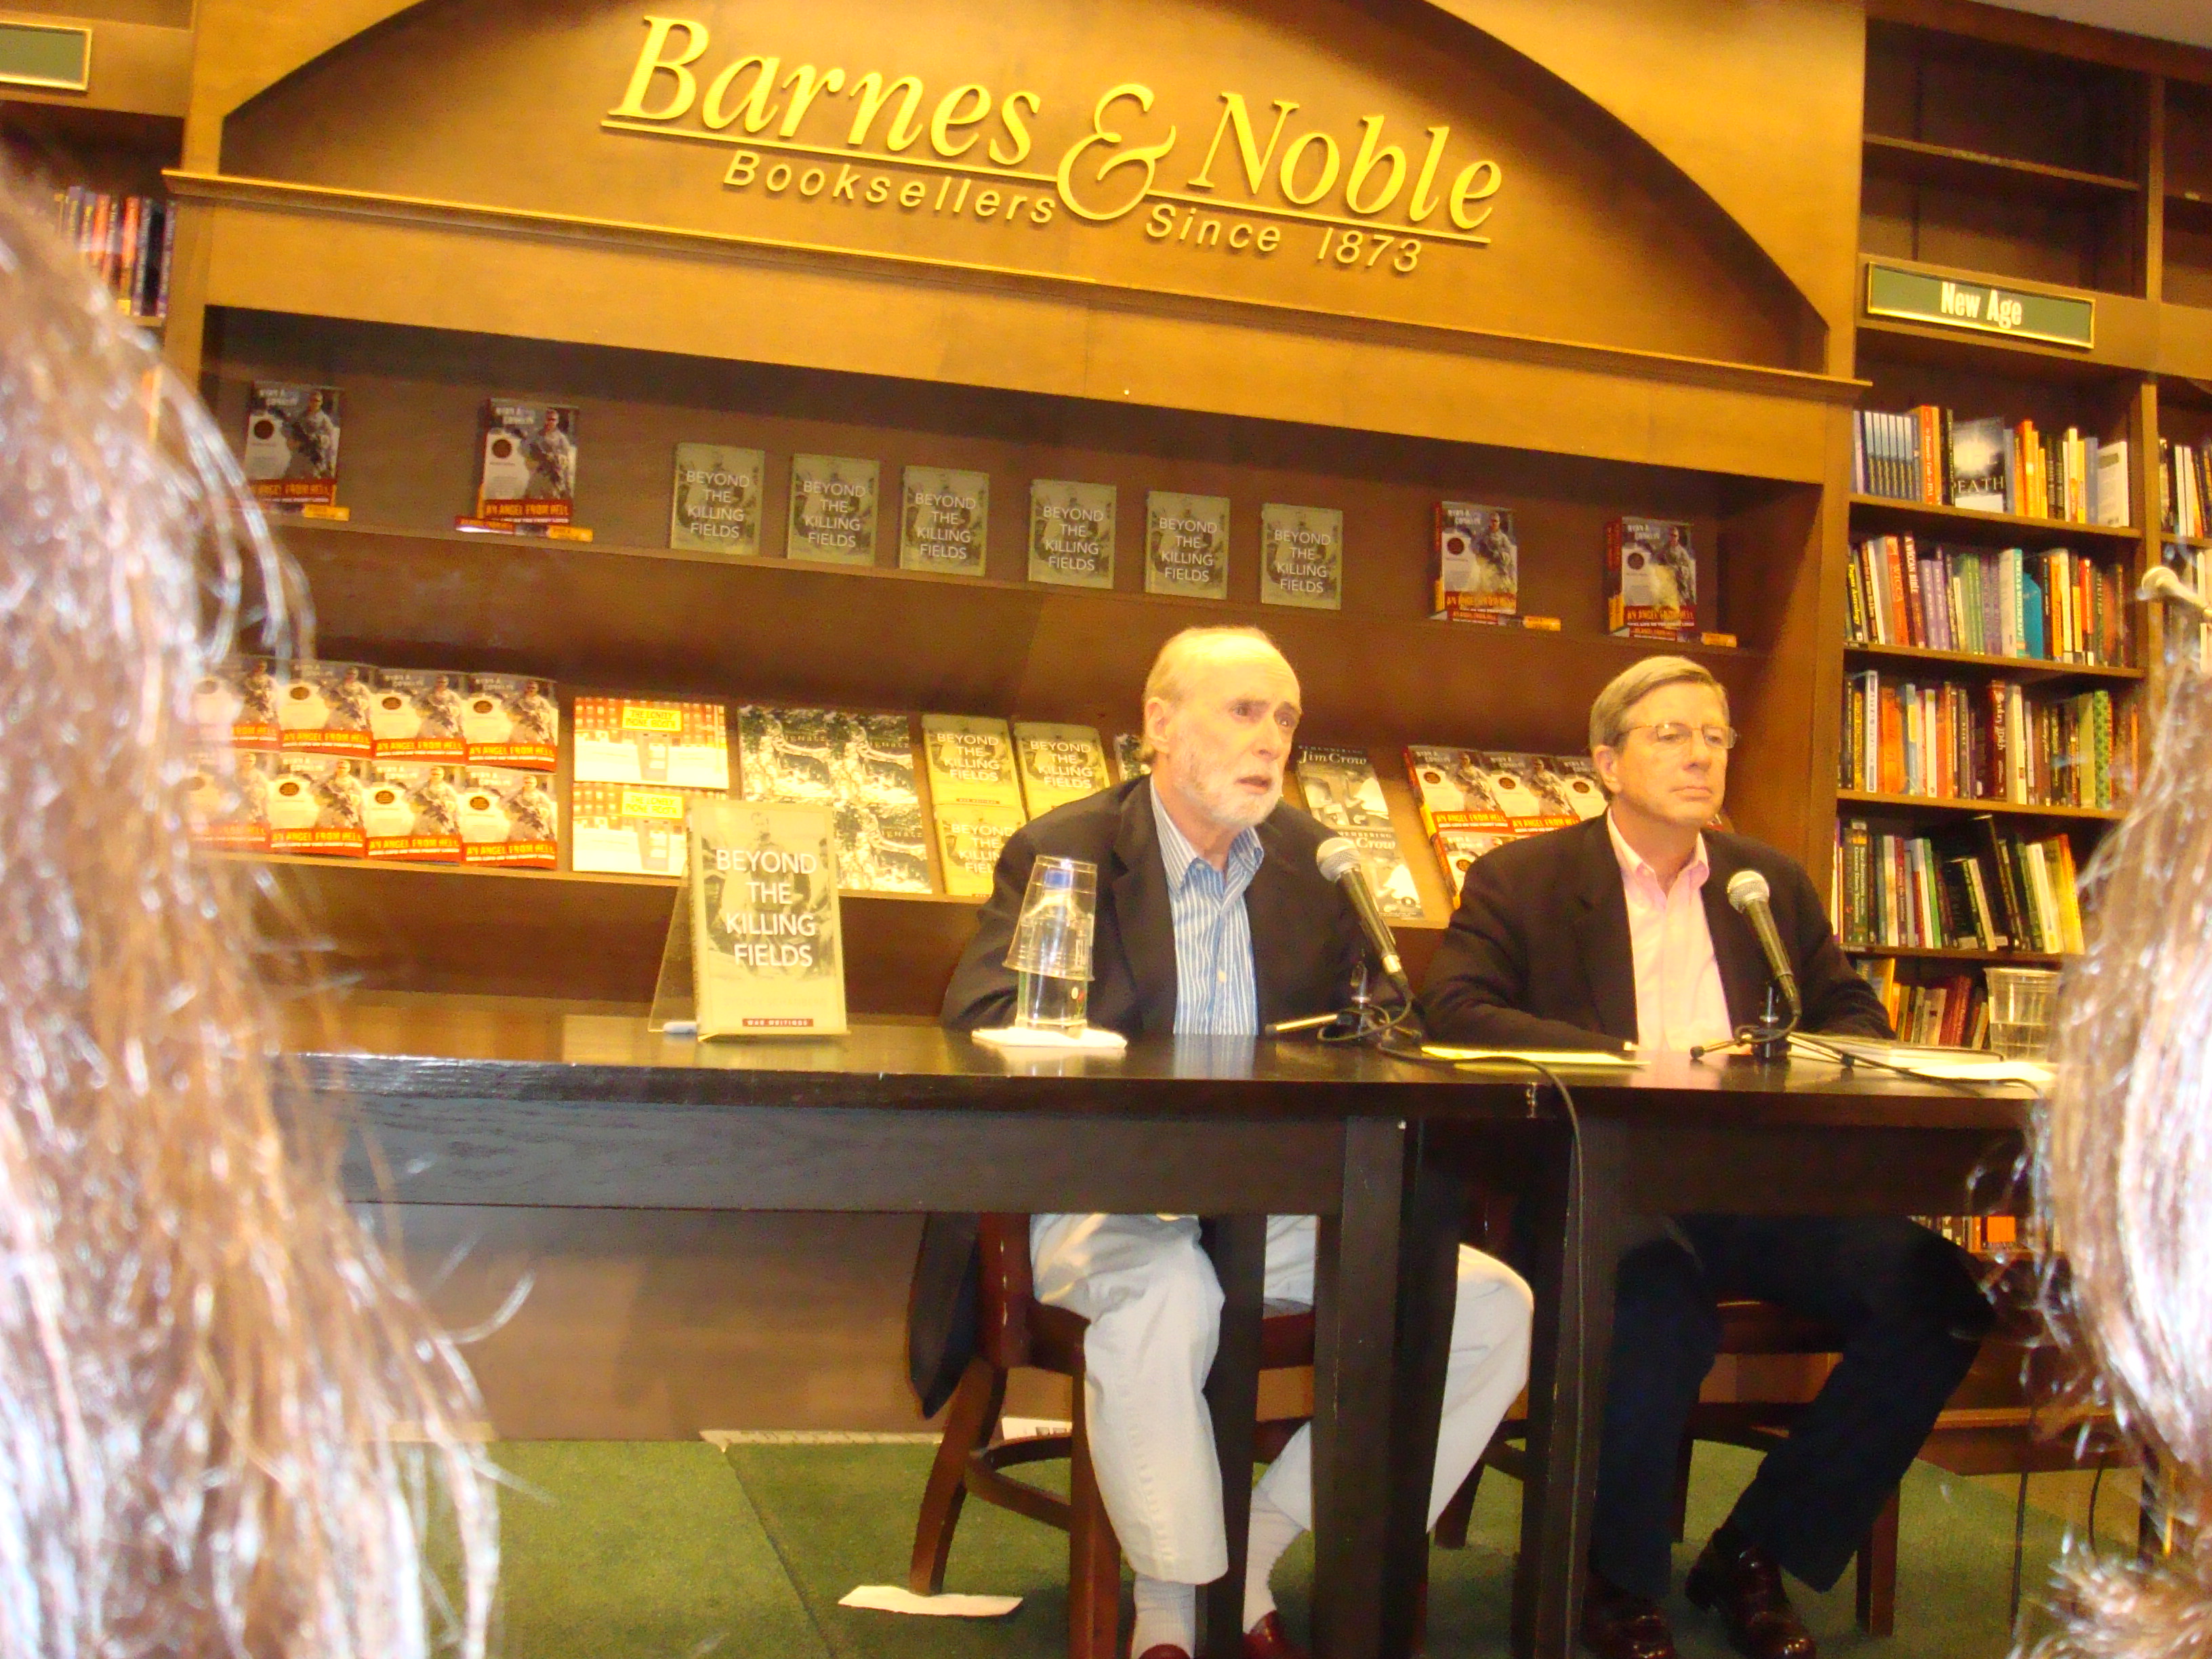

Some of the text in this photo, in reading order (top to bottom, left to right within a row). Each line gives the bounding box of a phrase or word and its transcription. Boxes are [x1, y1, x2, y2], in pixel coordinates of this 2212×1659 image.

[609, 14, 1502, 229] Barnes & Noble
[724, 150, 1421, 272] Booksellers Since 1873
[1941, 282, 2022, 329] New Age
[687, 470, 750, 488] BEYOND
[702, 489, 731, 504] THE
[803, 480, 866, 498] BEYOND
[820, 499, 848, 513] THE
[915, 493, 976, 510] BEYOND
[688, 506, 744, 522] KILLING
[932, 511, 958, 525] THE
[1044, 506, 1103, 522] BEYOND
[691, 523, 739, 539] FIELDS
[804, 516, 861, 531] KILLING
[1059, 524, 1086, 537] THE
[1159, 518, 1217, 533] BEYOND
[808, 533, 857, 548] FIELDS
[917, 527, 971, 543] KILLING
[1174, 535, 1201, 549] THE
[1275, 530, 1331, 546] BEYOND
[920, 544, 966, 560] FIELDS
[1046, 540, 1099, 555] KILLING
[1289, 548, 1315, 560] THE
[1048, 556, 1094, 571] FIELDS
[1162, 551, 1214, 567] KILLING
[1164, 567, 1209, 582] FIELDS
[1277, 562, 1327, 577] KILLING
[1280, 579, 1324, 593] FIELDS
[1893, 564, 1904, 602] WICCA
[1848, 564, 1861, 625] Pagan Astrology
[297, 733, 321, 742] ANGEL
[325, 733, 348, 742] FROM
[350, 734, 370, 743] HELL
[390, 741, 415, 750] ANGEL
[417, 741, 441, 750] FROM
[444, 742, 463, 750] HELL
[937, 733, 999, 745] BEYOND
[469, 746, 554, 757] AN ANGEL FROM HELL
[956, 746, 984, 757] THE
[1030, 741, 1091, 753] BEYOND
[944, 758, 1000, 770] KILLING
[1049, 754, 1078, 764] THE
[1299, 750, 1368, 765] Jim Crow
[950, 769, 998, 781] FIELDS
[1038, 765, 1092, 777] KILLING
[1044, 777, 1092, 789] FIELDS
[1448, 814, 1468, 822] ANGEL
[1469, 813, 1488, 821] FROM
[1490, 814, 1507, 822] HELL
[285, 832, 312, 841] ANGEL
[315, 832, 340, 841] FROM
[342, 832, 363, 842] HELL
[951, 823, 1015, 836] BEYOND
[384, 840, 408, 848] ANGEL
[412, 838, 436, 847] FROM
[438, 839, 459, 847] HELL
[466, 844, 555, 855] AN ANGEL FROM HELL
[971, 838, 1001, 848] THE
[1356, 838, 1395, 849] Crow
[716, 849, 817, 874] BEYOND
[960, 851, 1000, 861] KILLIN
[965, 862, 994, 874] FIEL
[745, 882, 792, 904] THE
[726, 913, 815, 936] KILLING
[734, 943, 813, 967] FIELDS
